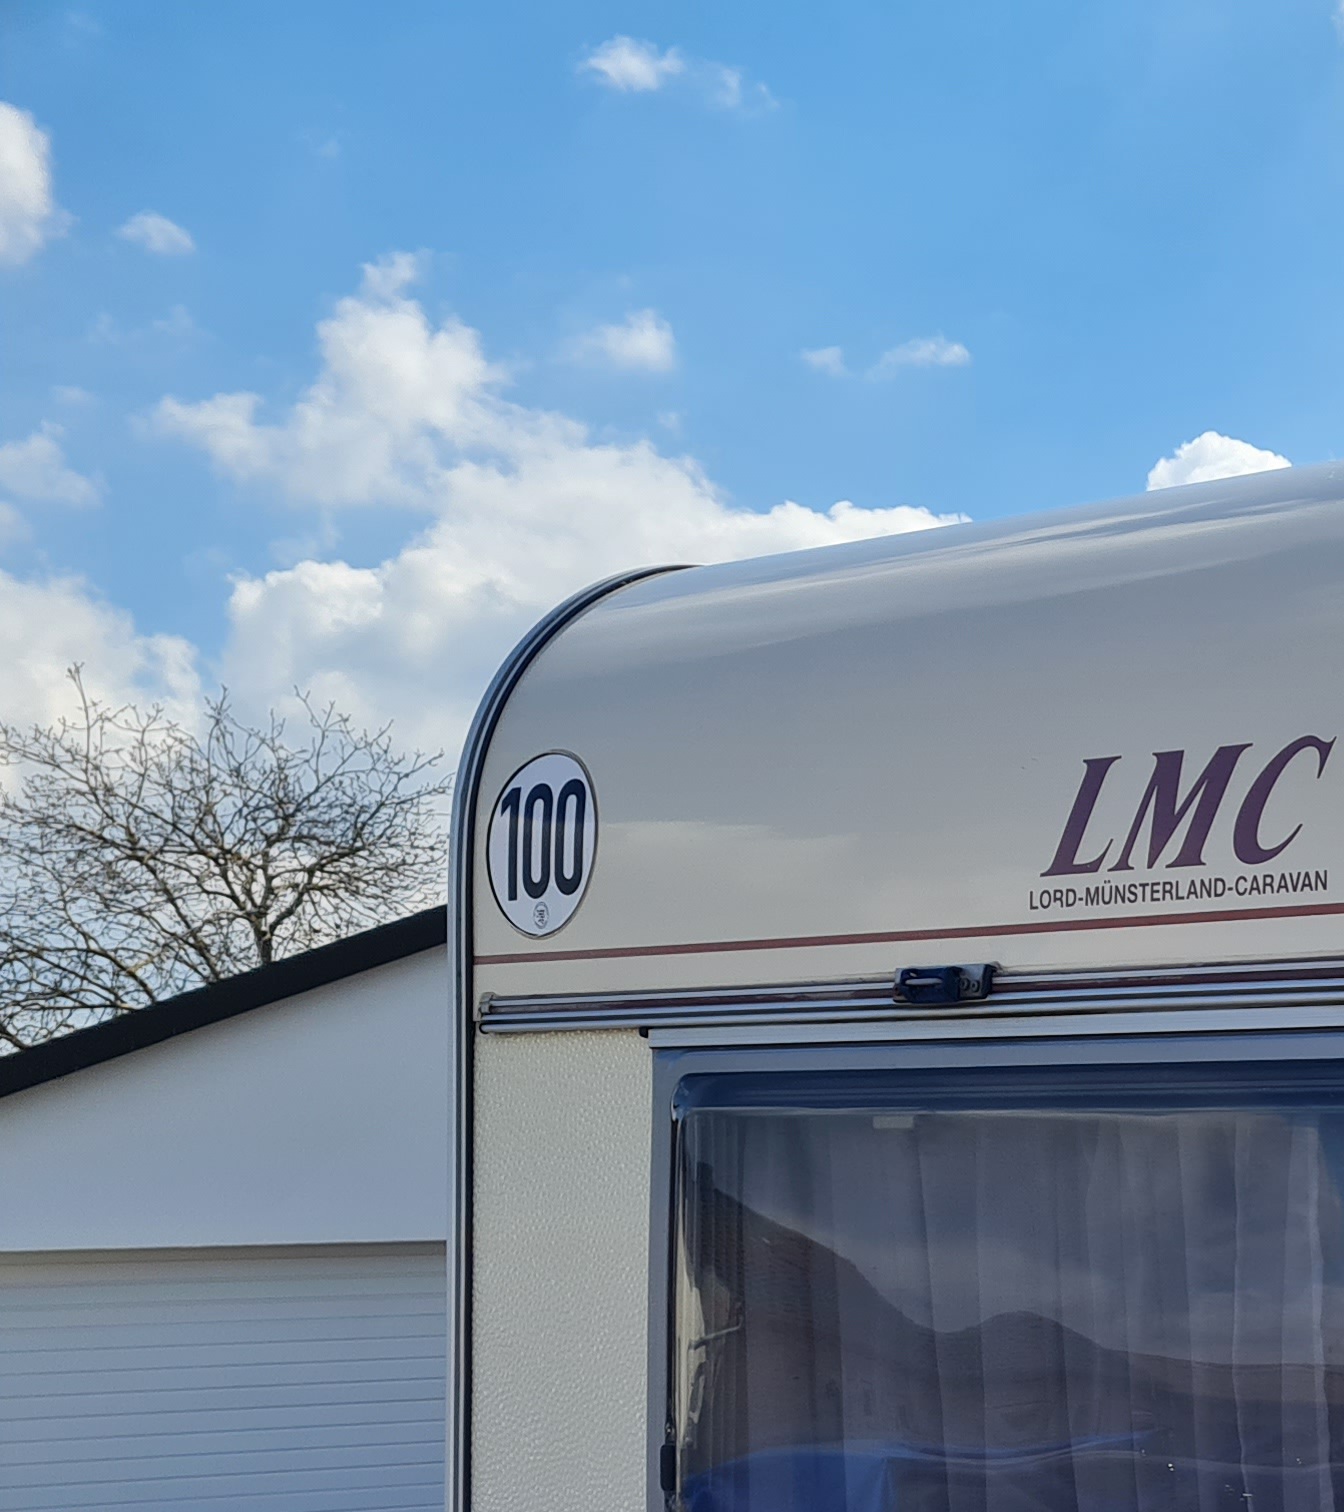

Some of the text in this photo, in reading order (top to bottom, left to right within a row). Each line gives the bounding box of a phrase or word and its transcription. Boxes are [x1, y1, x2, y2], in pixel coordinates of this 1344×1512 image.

[500, 778, 586, 901] 100
[1040, 735, 1337, 877] LMC
[1029, 870, 1328, 910] LORD-MÜNSTERLAND-CARAVAN
